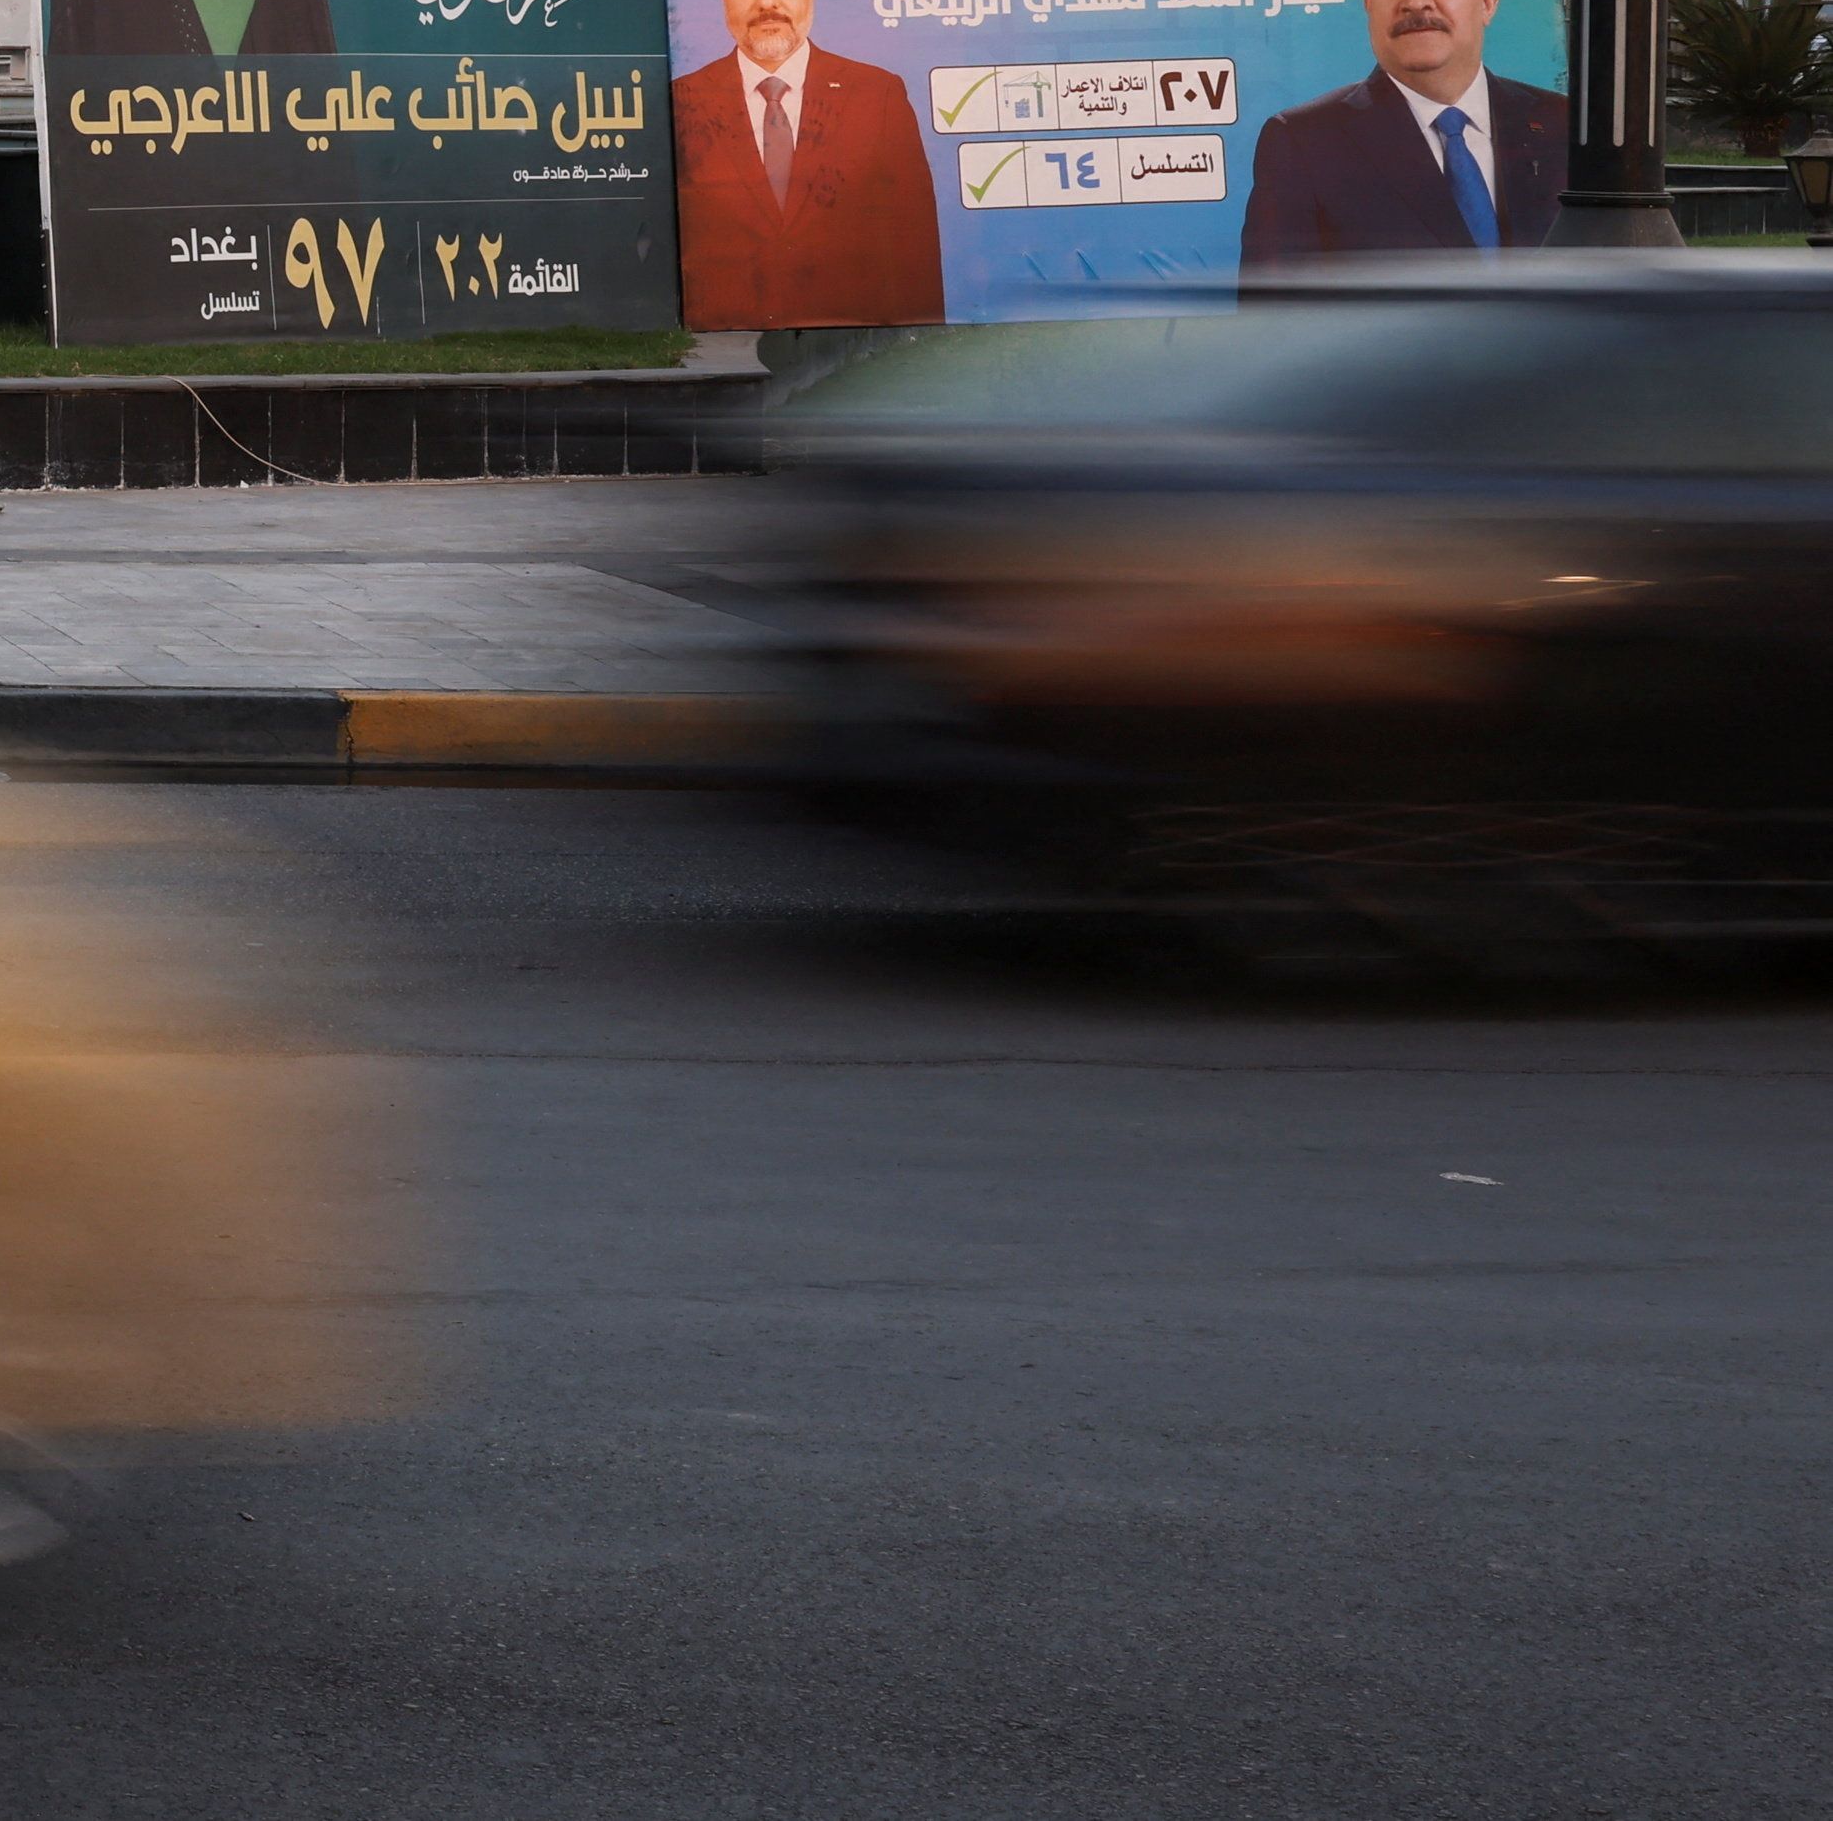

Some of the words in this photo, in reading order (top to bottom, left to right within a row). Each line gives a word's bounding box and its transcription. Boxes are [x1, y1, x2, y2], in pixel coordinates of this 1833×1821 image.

[70, 70, 270, 156] الاعرجي
[285, 70, 395, 153] علي
[408, 56, 539, 150] صائب
[551, 69, 644, 153] نبيل
[1158, 69, 1230, 112] ٢٠٧
[1045, 151, 1101, 190] ٦٤
[1130, 152, 1214, 179] التسلسل
[169, 226, 258, 272] بغداد
[284, 216, 386, 330] ٩٧
[507, 257, 580, 296] القائمة
[200, 290, 261, 320] تسلسل
